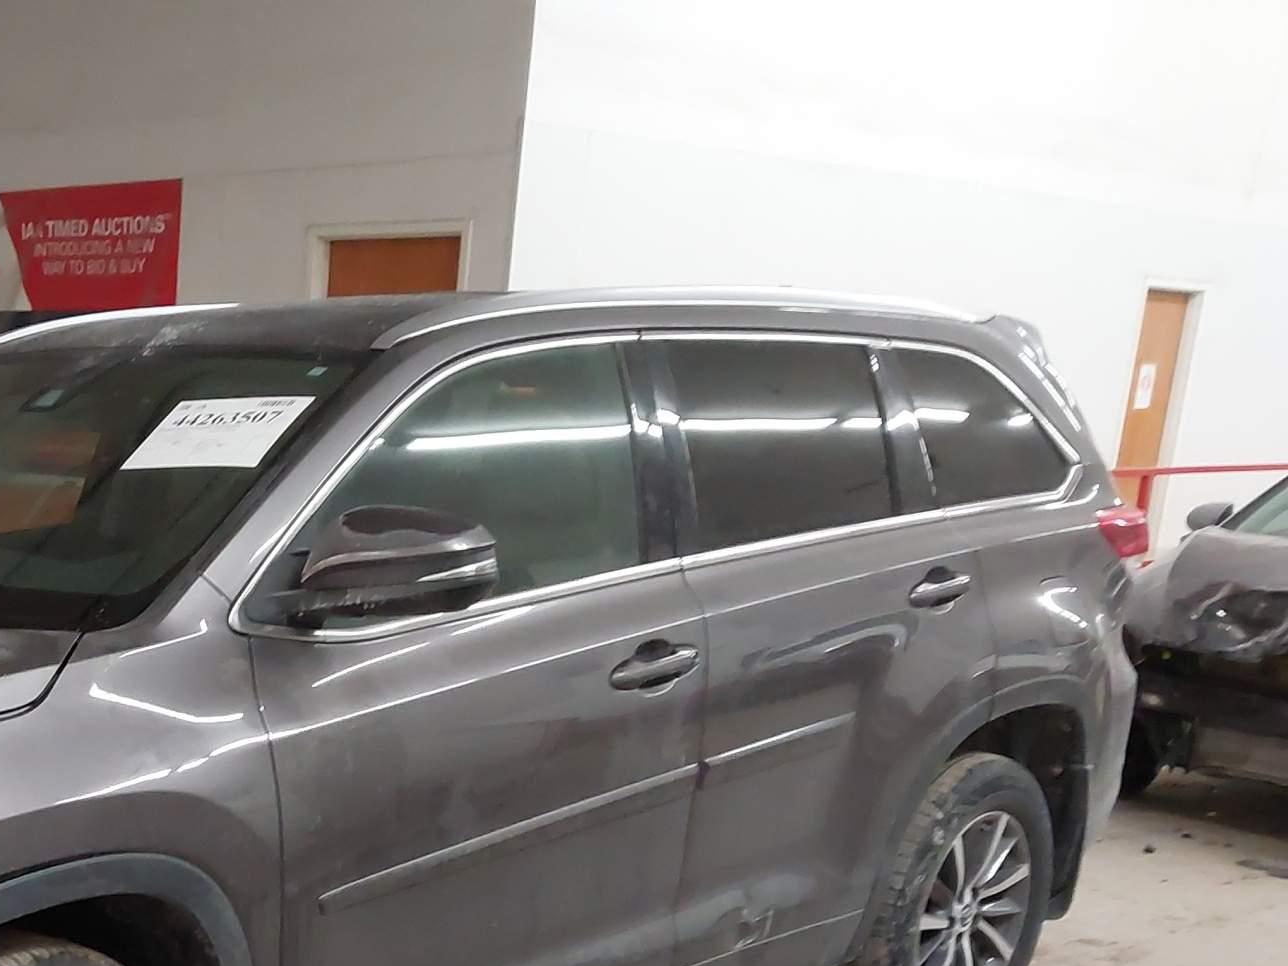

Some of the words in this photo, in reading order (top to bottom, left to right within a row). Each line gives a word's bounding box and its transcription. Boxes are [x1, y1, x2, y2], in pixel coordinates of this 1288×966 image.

[45, 219, 88, 238] TIMED
[69, 259, 84, 275] TO
[173, 409, 285, 427] 44263507
